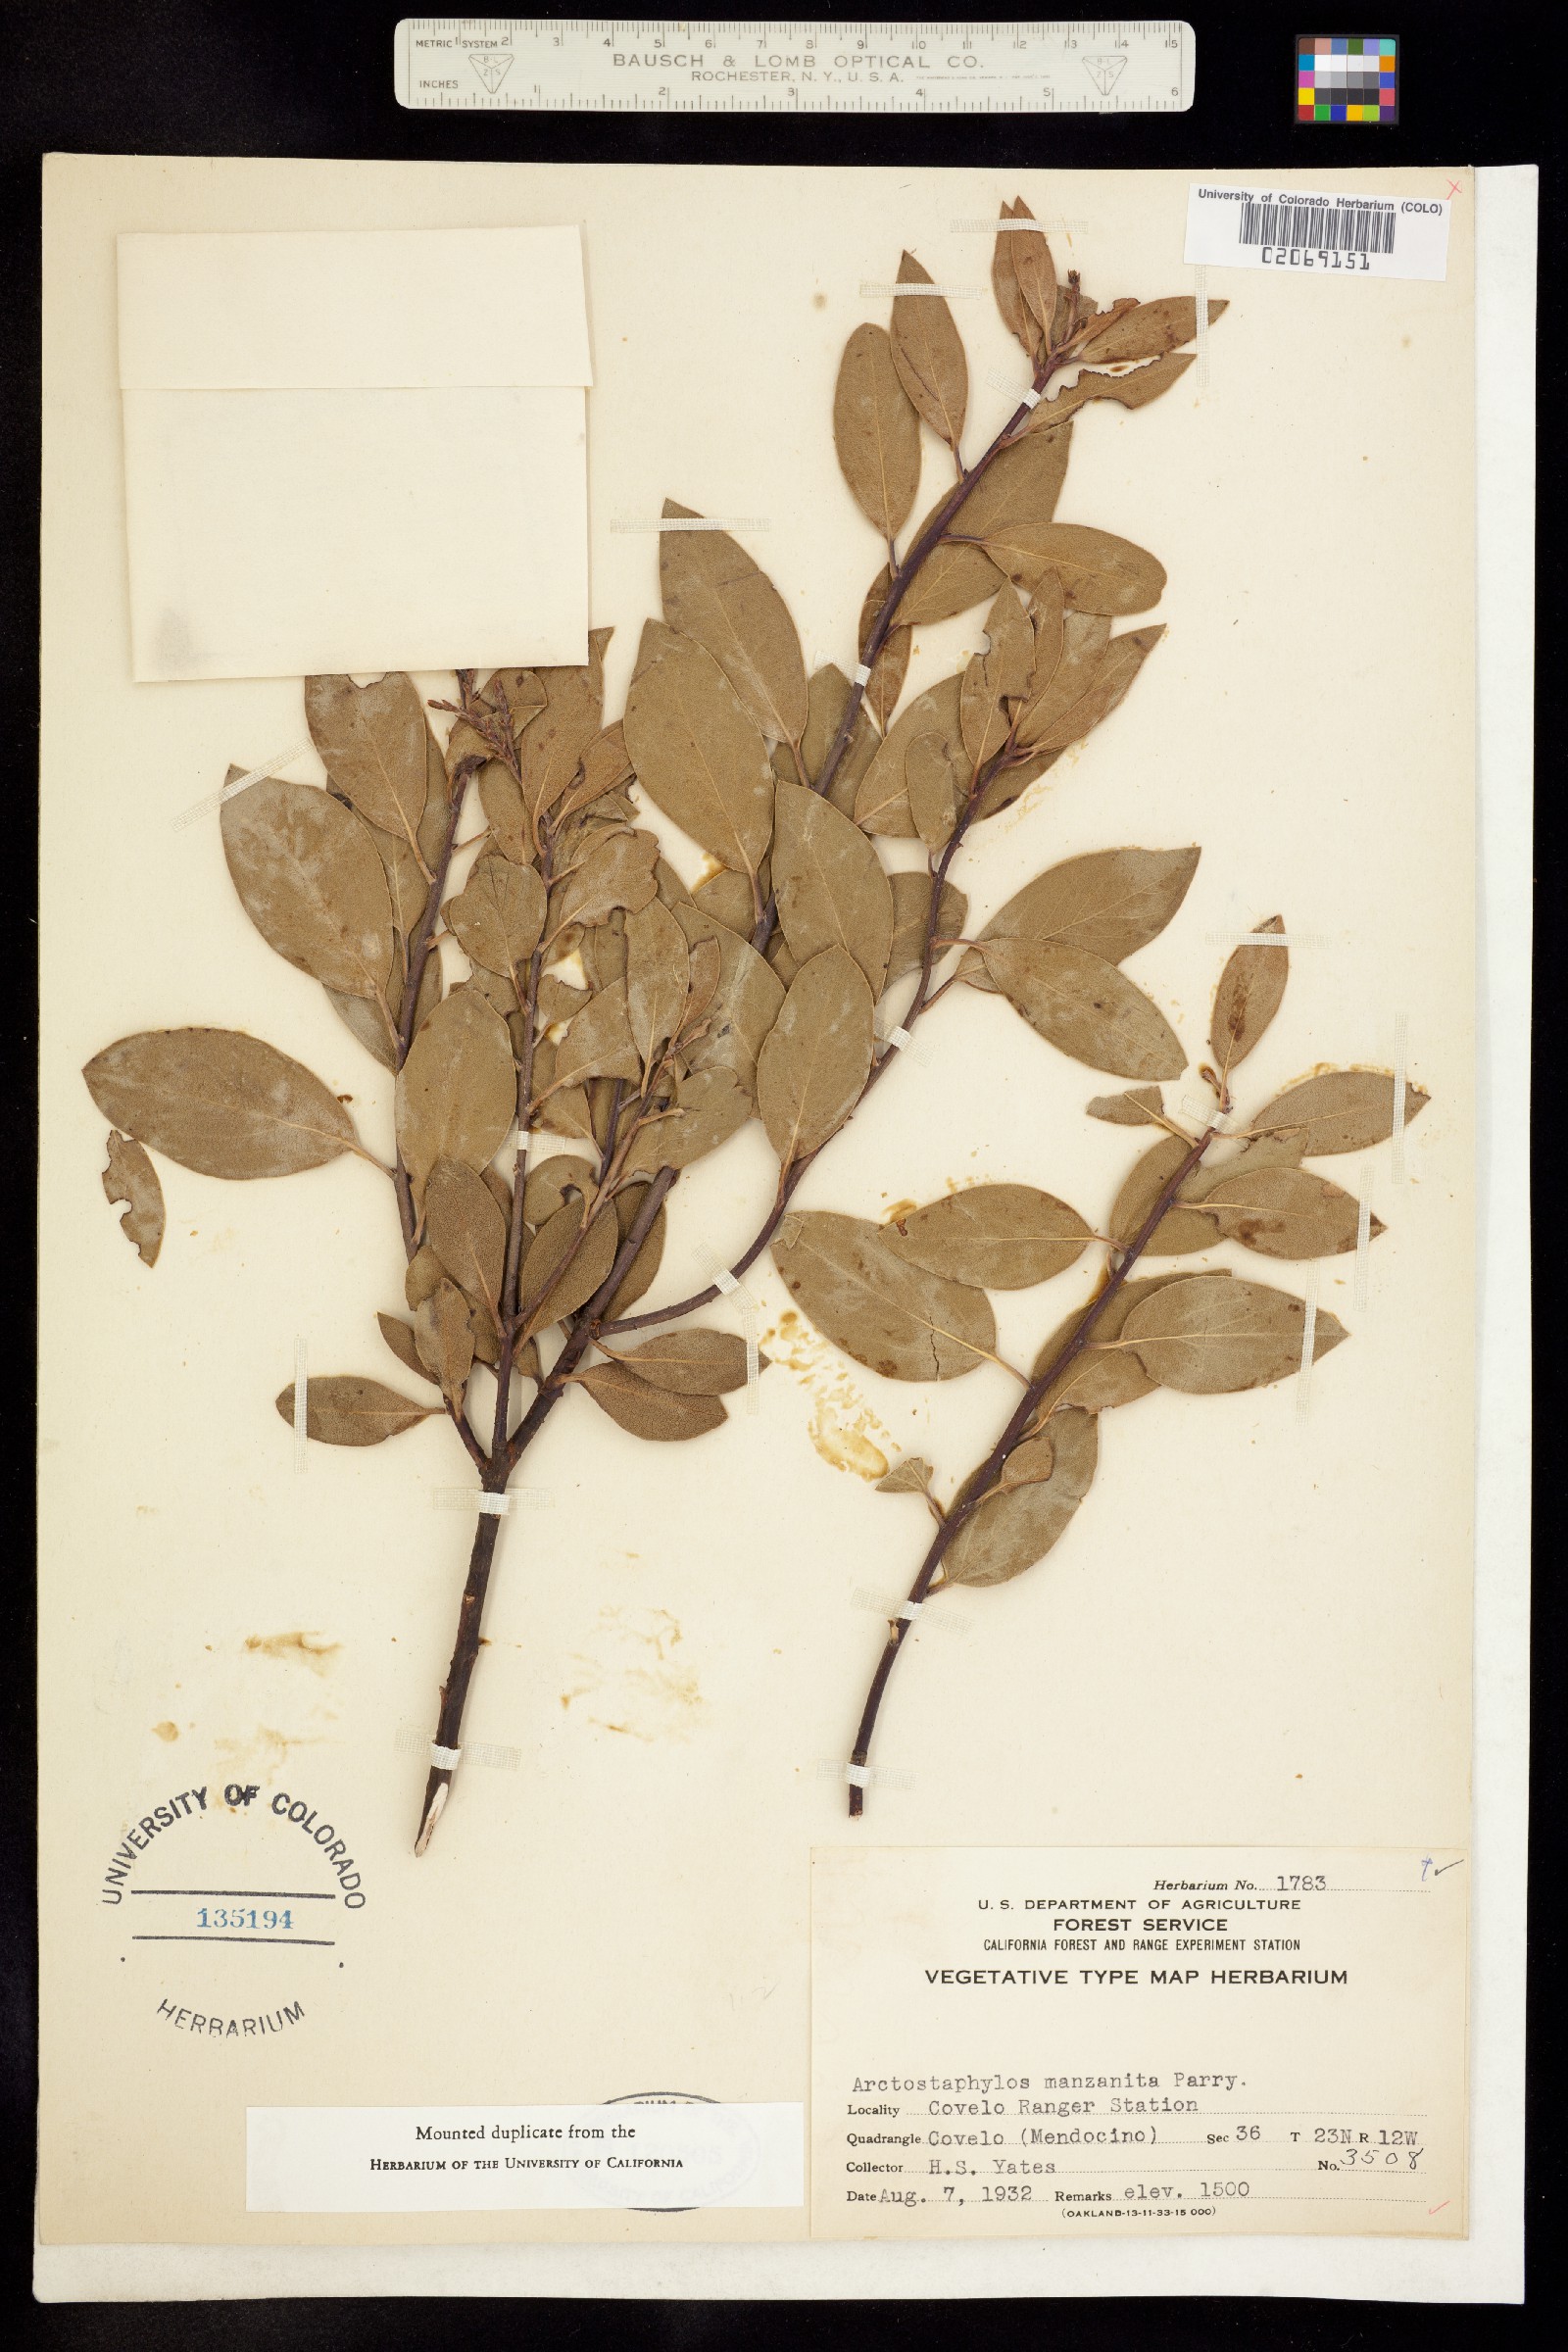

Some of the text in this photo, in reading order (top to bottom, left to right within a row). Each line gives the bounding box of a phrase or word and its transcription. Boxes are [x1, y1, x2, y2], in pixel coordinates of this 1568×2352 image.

[416, 39, 498, 49] METRIC SYSTEM
[501, 37, 509, 46] 2
[553, 37, 560, 46] 3
[603, 38, 612, 47] 4
[654, 39, 662, 48] 5
[705, 39, 712, 48] 6
[757, 39, 763, 48] 7
[806, 40, 813, 49] 8
[857, 40, 864, 49] 9
[911, 40, 926, 49] 10
[962, 40, 972, 49] 11
[1013, 40, 1027, 49] 12
[1064, 40, 1077, 49] 13
[1115, 40, 1129, 49] 14
[1165, 40, 1178, 49] 15
[613, 54, 984, 69] BAUSCH & LOMB OPTICAL CO.
[418, 79, 459, 89] INCHES
[691, 71, 796, 83] ROCHESTER,
[659, 87, 666, 96] 2
[787, 87, 795, 96] 3
[915, 88, 924, 97] 4
[1043, 88, 1051, 97] 5
[1171, 88, 1179, 97] 6
[1198, 188, 1443, 215] University of Colorado Herbarium (COLO)
[1261, 247, 1370, 270] 02069151
[102, 1784, 367, 1909] UNIVERSITY OF COLORADO
[1153, 1876, 1327, 1891] Herbarium No. 1783
[1025, 1899, 1137, 1910] DEPARTMENT
[1148, 1899, 1171, 1910] OF
[1181, 1899, 1301, 1910] AGRICULTURE
[196, 1908, 295, 1930] 135194
[1054, 1918, 1228, 1932] FOREST SERVICE
[983, 1938, 1300, 1951] CALIFORNIA FOREST AND RANGE EXPERIMENT STATION
[925, 1970, 1348, 1984] VEGETATIVE TYPE MAP HERBARIUM
[853, 2072, 1247, 2094] Arctostaphylos manzanita Parry.
[847, 2096, 1199, 2118] Locality Covelo Ranger Station
[416, 2124, 636, 2143] Mounted duplicate from the
[846, 2126, 1418, 2147] Quadrangle Covelo (Mendocino) Sec 36 T 23N R 12W
[1340, 2147, 1424, 2170] 3508
[846, 2159, 1341, 2177] Collector H.S. Yates No.
[846, 2181, 1250, 2207] Date Aug. 7, 1932 Remarks elev. 1500
